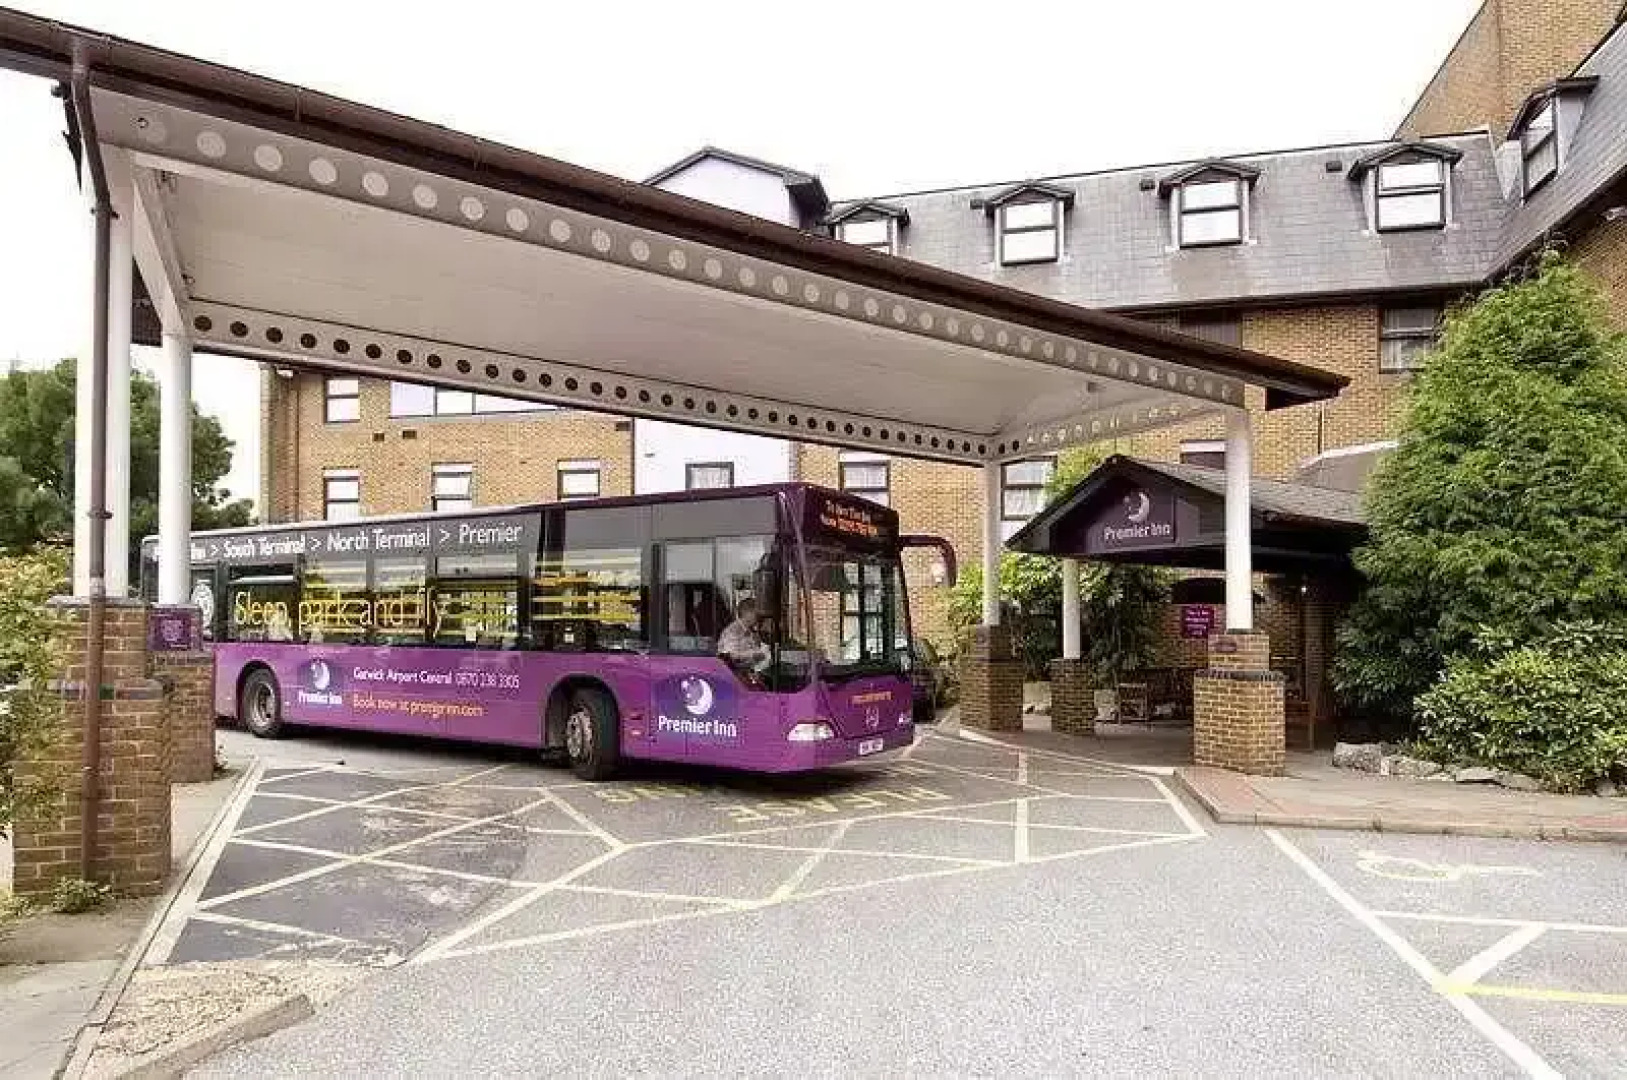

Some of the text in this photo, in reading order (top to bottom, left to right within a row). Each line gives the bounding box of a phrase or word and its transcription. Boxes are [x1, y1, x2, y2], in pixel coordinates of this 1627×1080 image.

[223, 539, 255, 558] South
[258, 534, 305, 556] Terminal
[327, 530, 369, 551] North
[372, 525, 430, 550] Terminal
[459, 522, 523, 544] Premier
[1104, 522, 1170, 540] Premier Inn
[298, 689, 328, 705] Premier
[658, 715, 737, 737] Premier Inn
